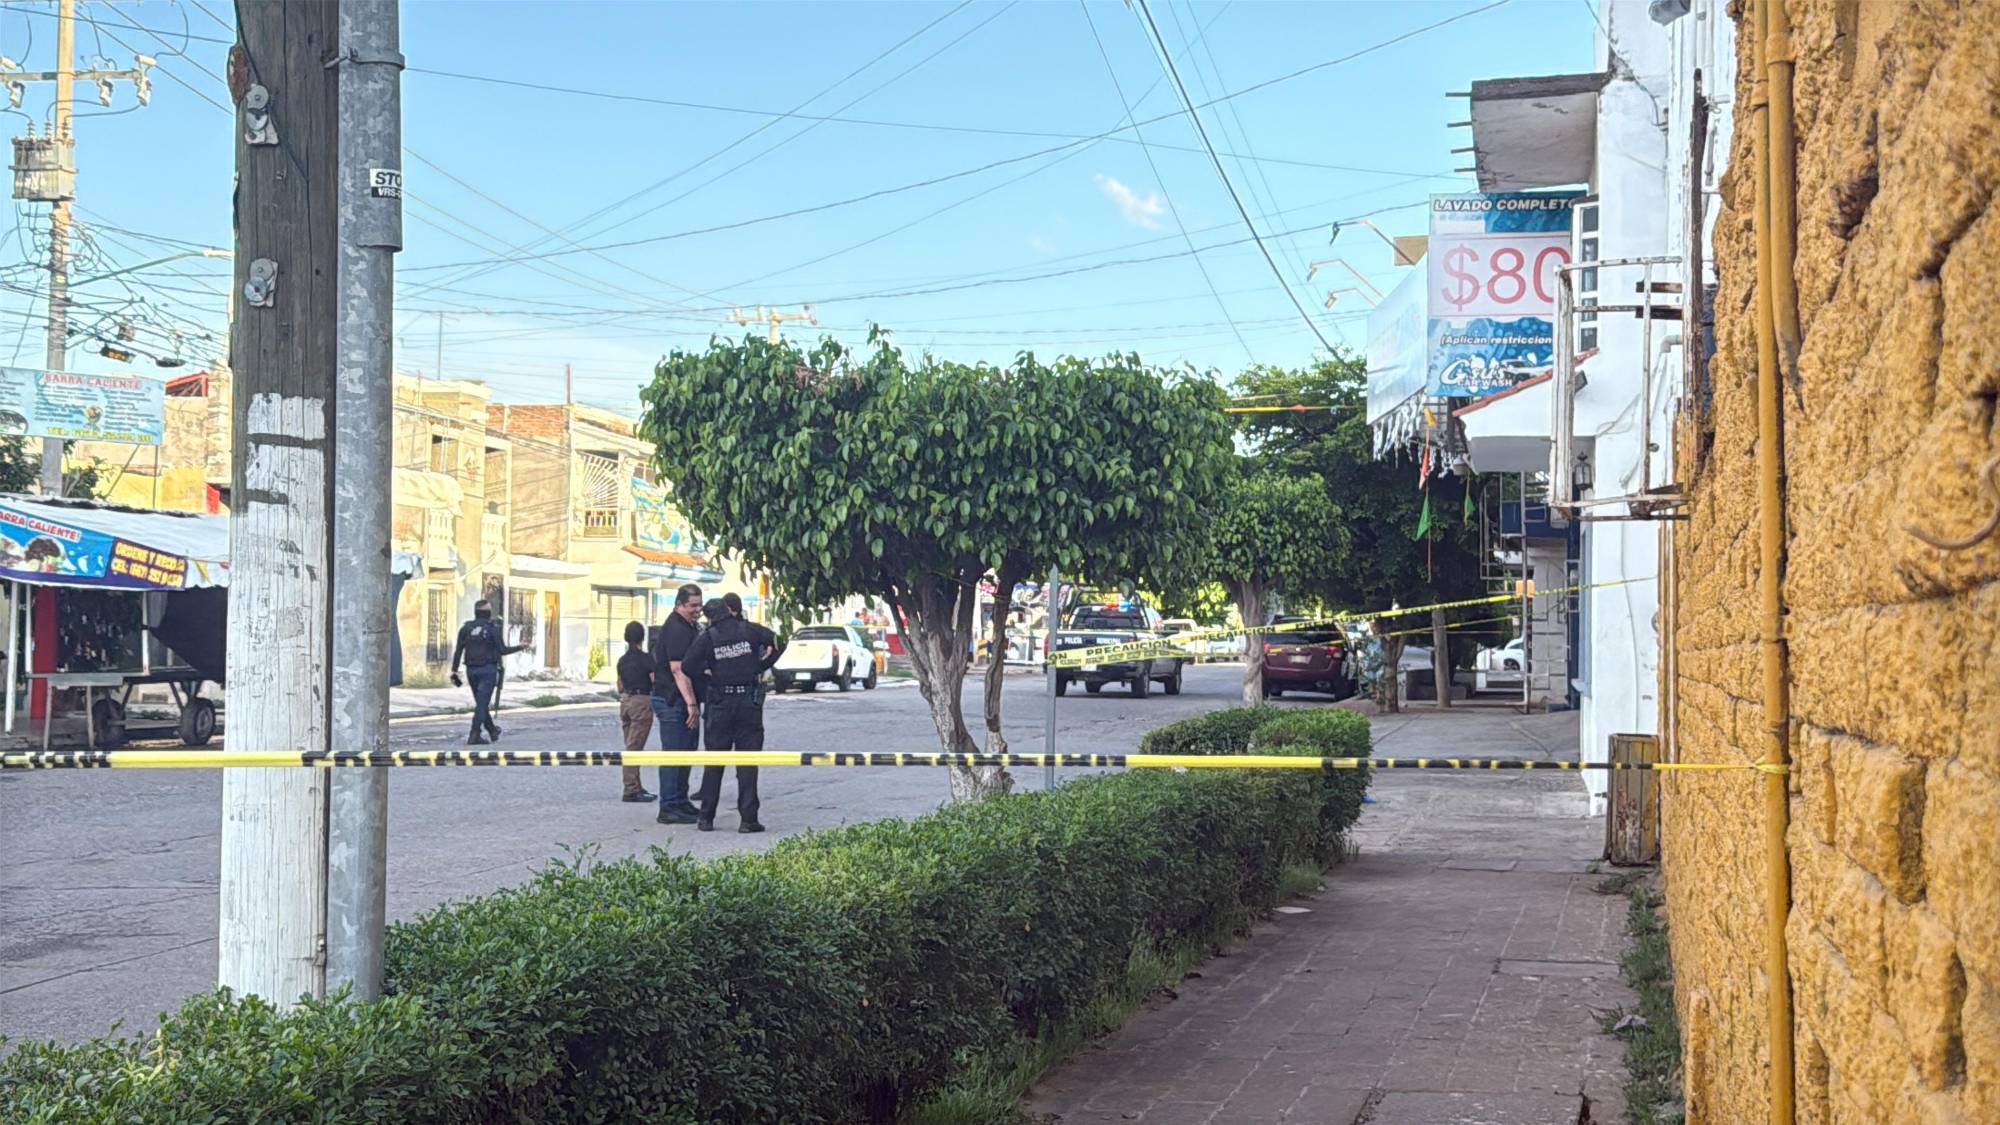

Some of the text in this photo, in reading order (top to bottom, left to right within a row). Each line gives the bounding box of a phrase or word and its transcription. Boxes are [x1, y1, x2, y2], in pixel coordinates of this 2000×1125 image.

[1434, 199, 1492, 211] LAVADO
[1441, 244, 1573, 312] $80
[1440, 335, 1488, 345] (Aplican
[44, 372, 142, 389] BARRA CALIENTE
[1482, 378, 1513, 387] WASH
[28, 520, 81, 540] CALIENTE!
